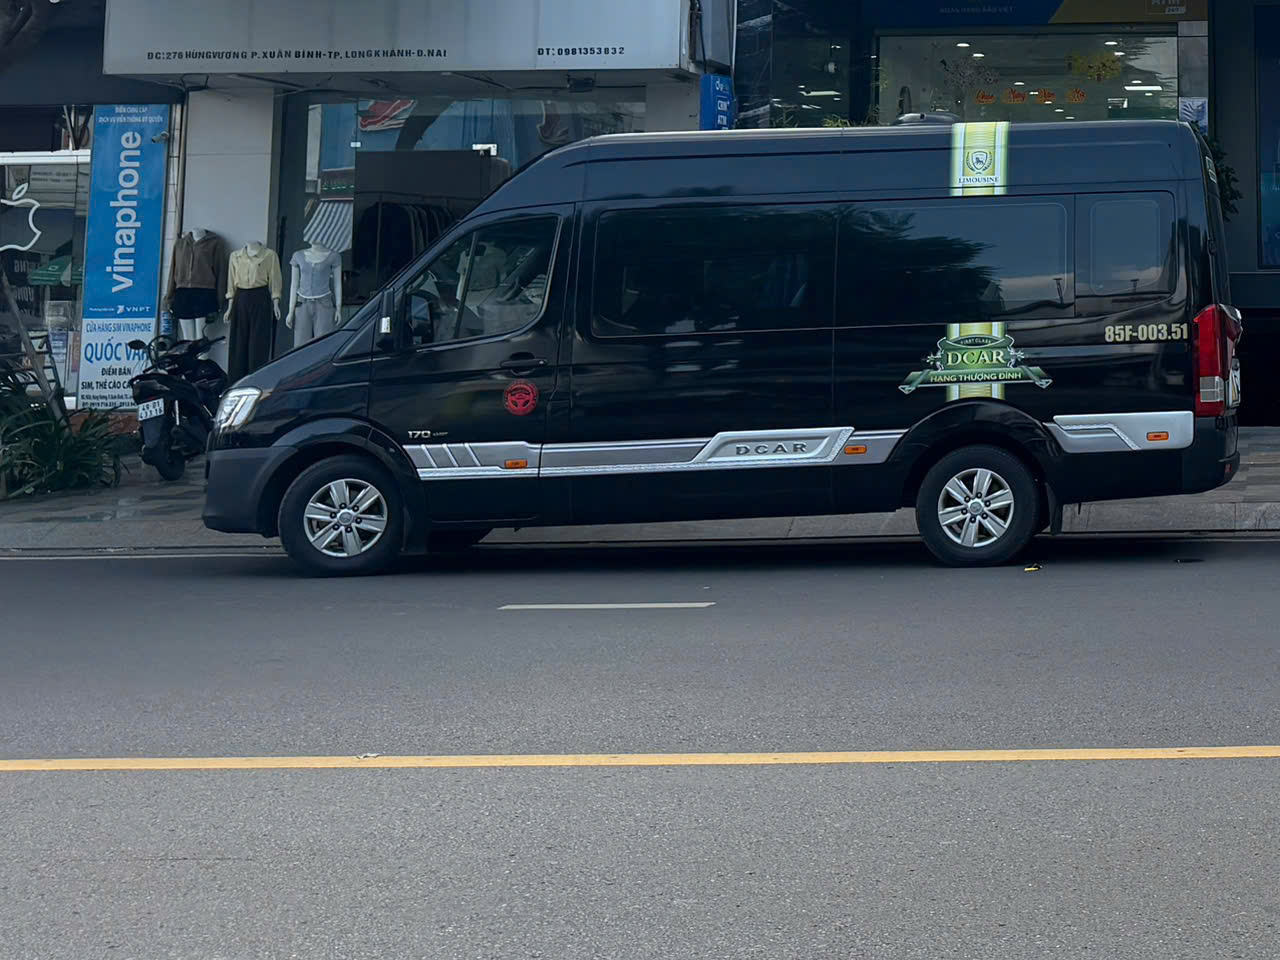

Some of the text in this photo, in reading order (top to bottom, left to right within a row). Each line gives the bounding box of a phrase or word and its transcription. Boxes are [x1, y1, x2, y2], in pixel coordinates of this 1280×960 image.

[958, 176, 1000, 184] LIMOUSINE
[106, 130, 142, 293] vinaphone
[1104, 323, 1188, 342] 85F-003.51
[83, 336, 122, 364] QUỐC
[946, 350, 1006, 366] DCAR
[101, 365, 132, 376] ĐIỂM BÁN
[958, 373, 997, 382] THƯỢNG
[80, 381, 95, 391] SIM,
[95, 380, 108, 390] THẺ
[107, 379, 122, 390] CÀO
[407, 430, 431, 439] 170
[735, 441, 807, 456] DCAR
